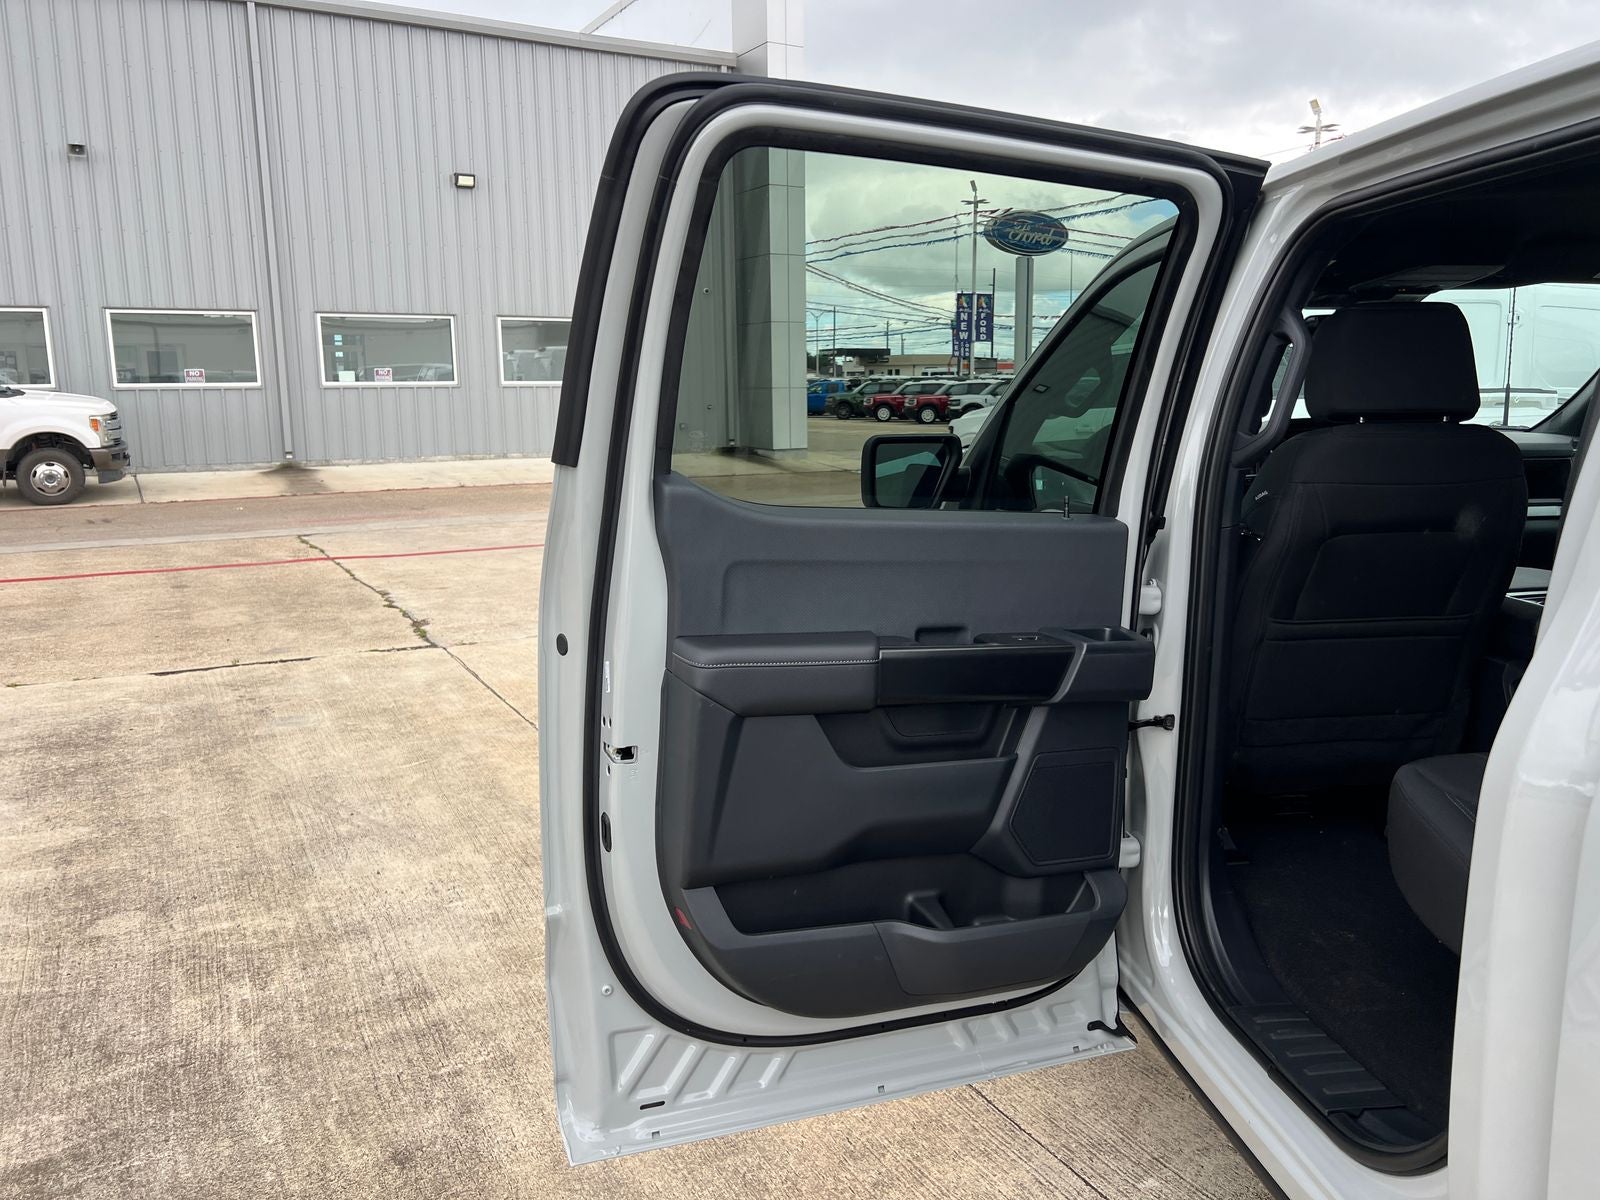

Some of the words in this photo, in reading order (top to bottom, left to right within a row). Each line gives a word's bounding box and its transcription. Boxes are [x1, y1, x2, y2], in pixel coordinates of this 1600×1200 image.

[1007, 220, 1055, 246] Ford
[959, 313, 969, 340] NEW
[979, 313, 987, 340] FORD
